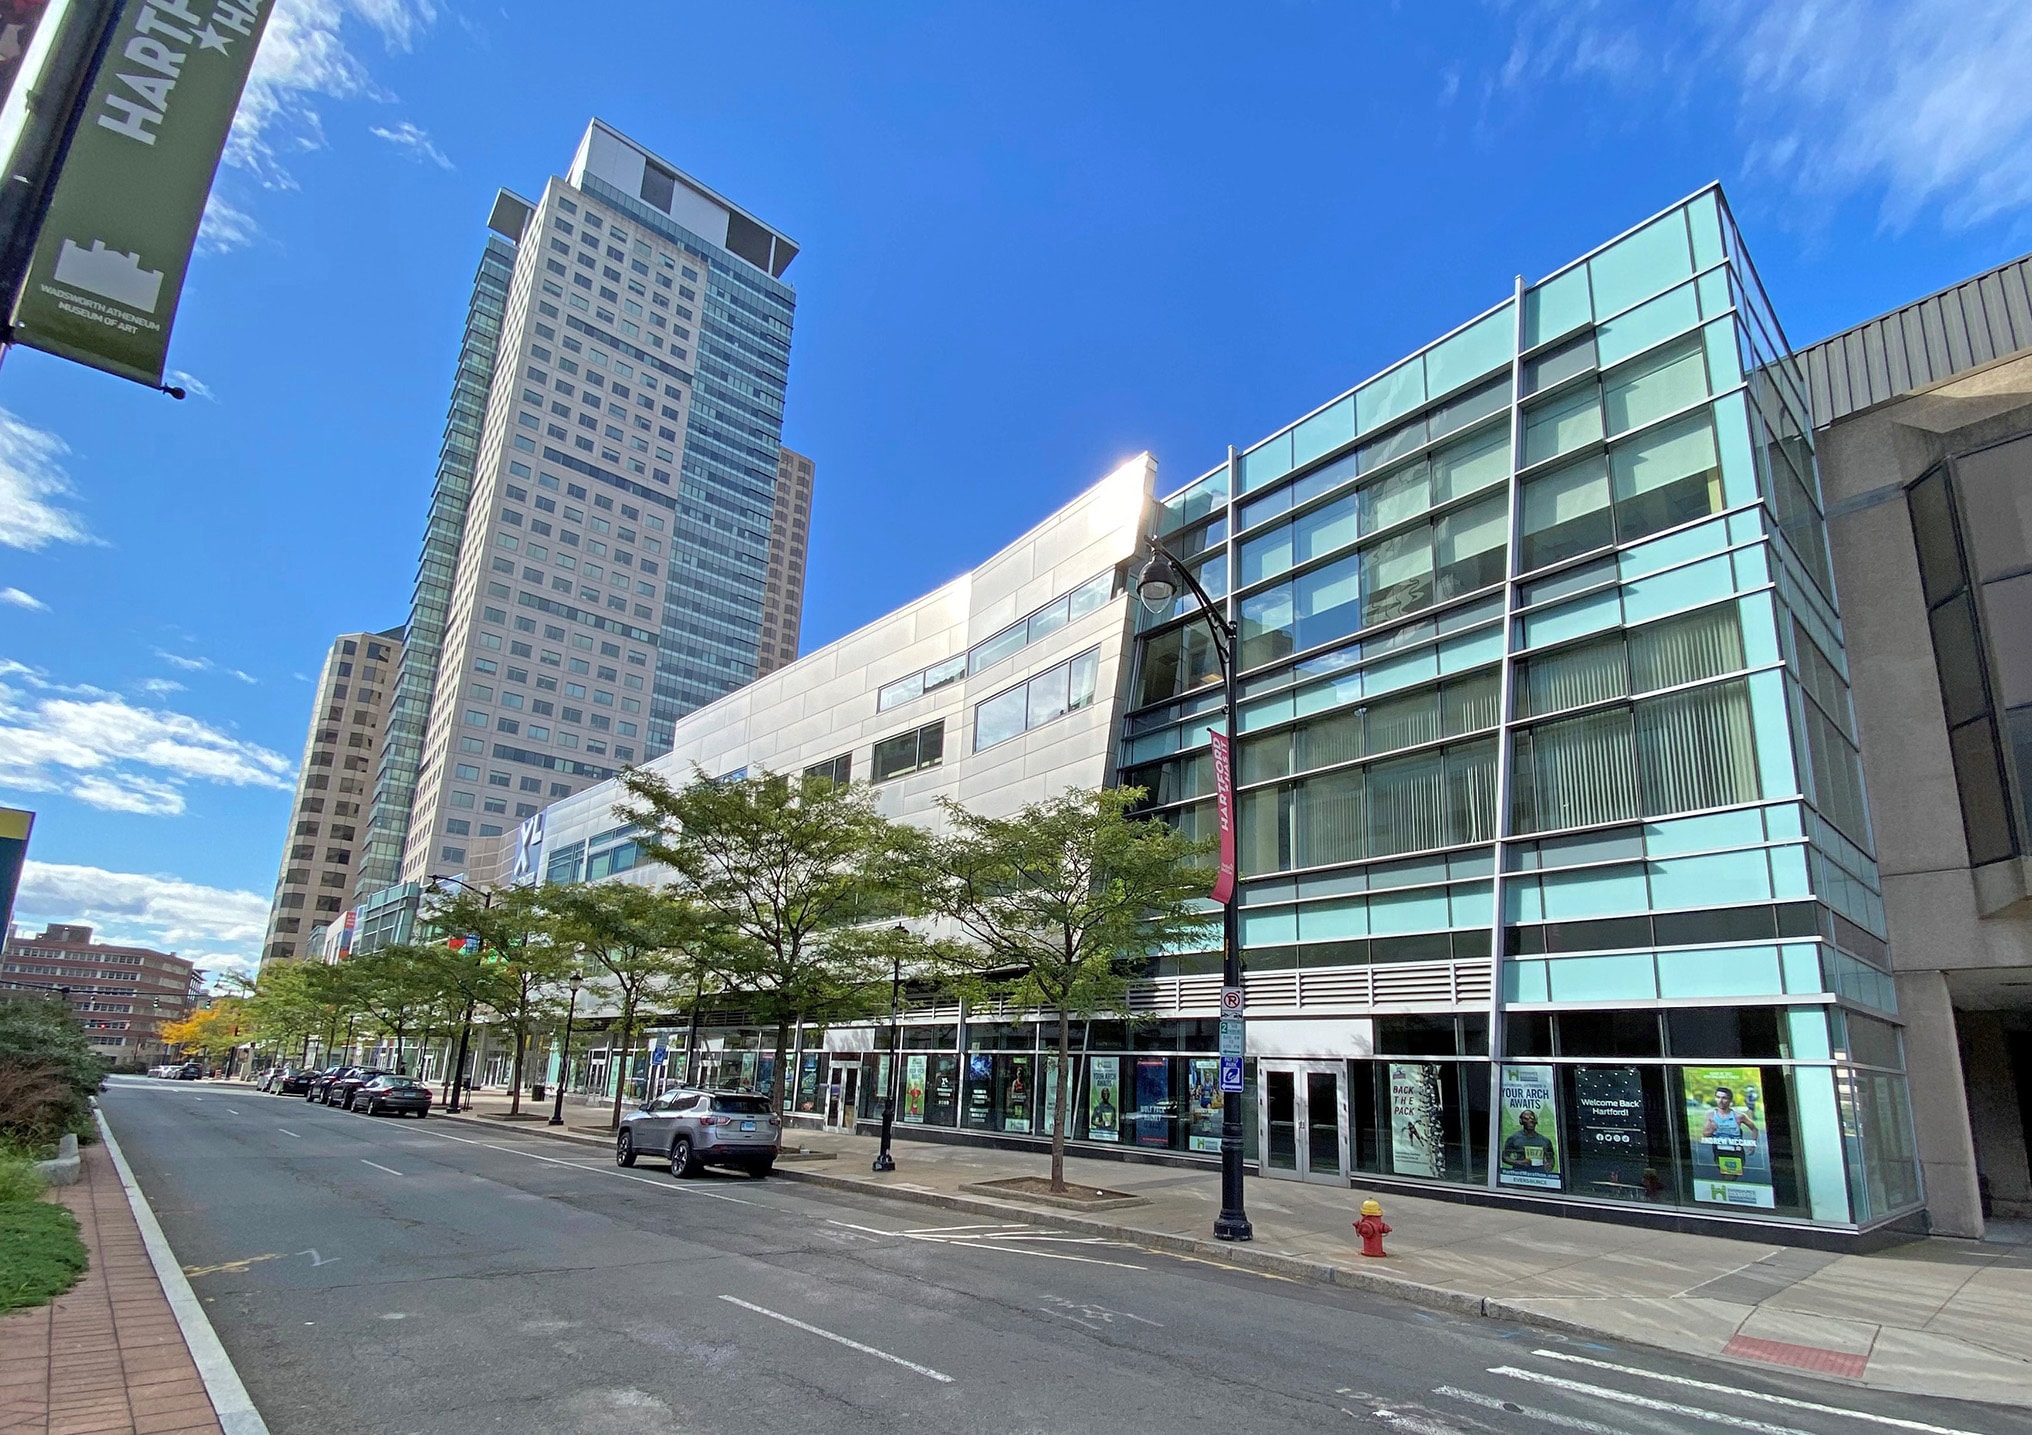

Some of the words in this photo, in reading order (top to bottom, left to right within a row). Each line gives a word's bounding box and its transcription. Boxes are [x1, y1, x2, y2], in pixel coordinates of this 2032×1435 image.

[40, 283, 106, 312] WADSWORTH
[104, 307, 160, 332] ATHENEUM
[58, 301, 103, 322] MUSEUM
[103, 316, 118, 327] OF
[117, 322, 139, 335] ART
[1212, 737, 1229, 831] HARTFORD
[513, 813, 543, 876] XL
[1393, 1086, 1414, 1094] BACK
[1502, 1088, 1524, 1098] YOUR
[1525, 1089, 1549, 1099] ARCH
[1394, 1096, 1414, 1105] THE
[1510, 1098, 1541, 1109] AWAITS
[1581, 1099, 1618, 1107] Welcome
[1619, 1100, 1640, 1108] Back
[1394, 1107, 1415, 1115] PACK
[1592, 1108, 1629, 1116] Hartford!
